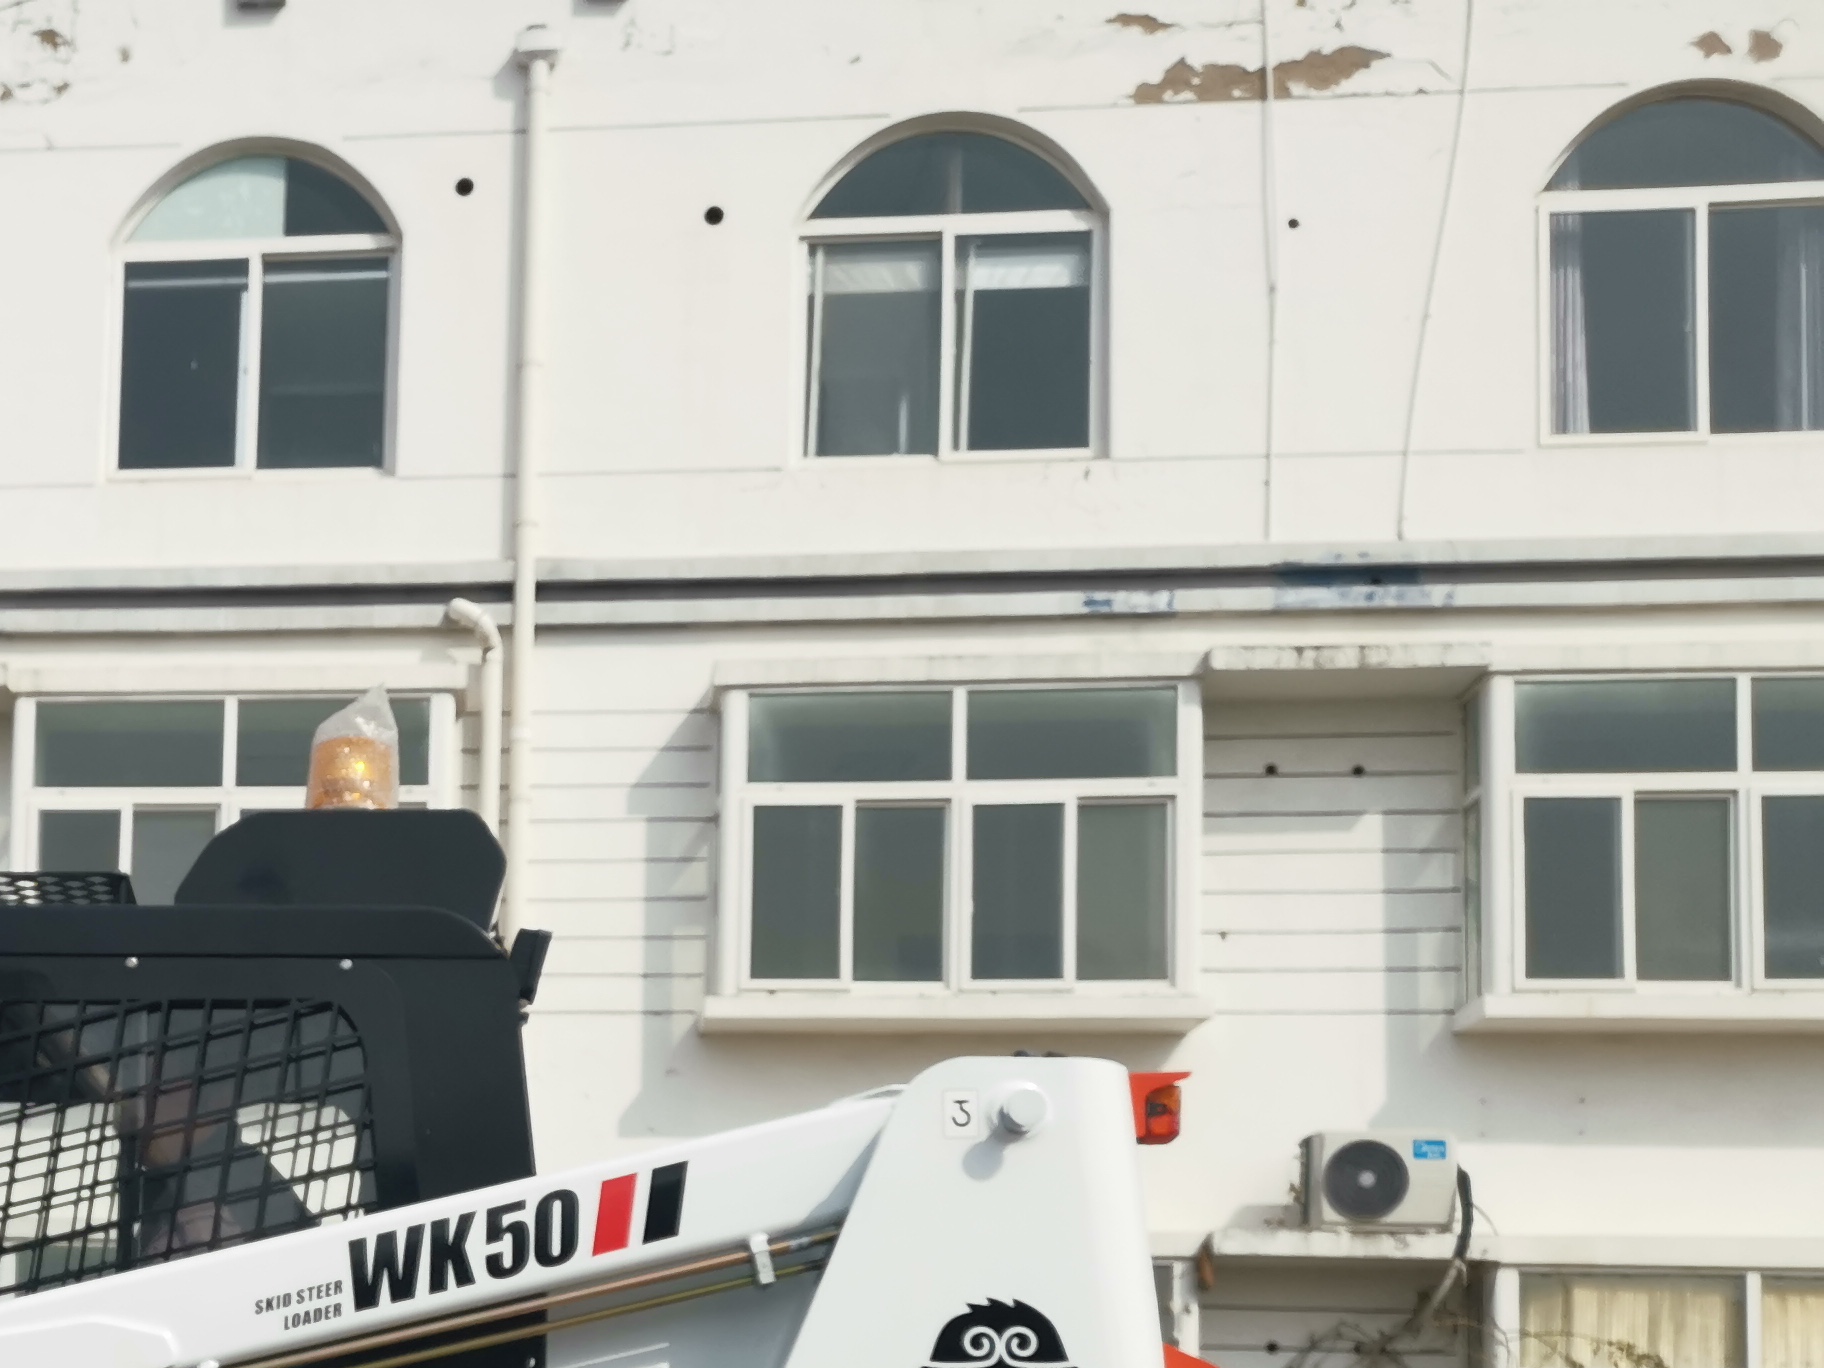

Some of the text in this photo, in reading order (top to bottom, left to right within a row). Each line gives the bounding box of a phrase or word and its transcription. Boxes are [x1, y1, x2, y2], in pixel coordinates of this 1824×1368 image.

[348, 1188, 580, 1313] WK50
[254, 1279, 343, 1315] SKID STEER
[283, 1302, 343, 1331] LOADER
